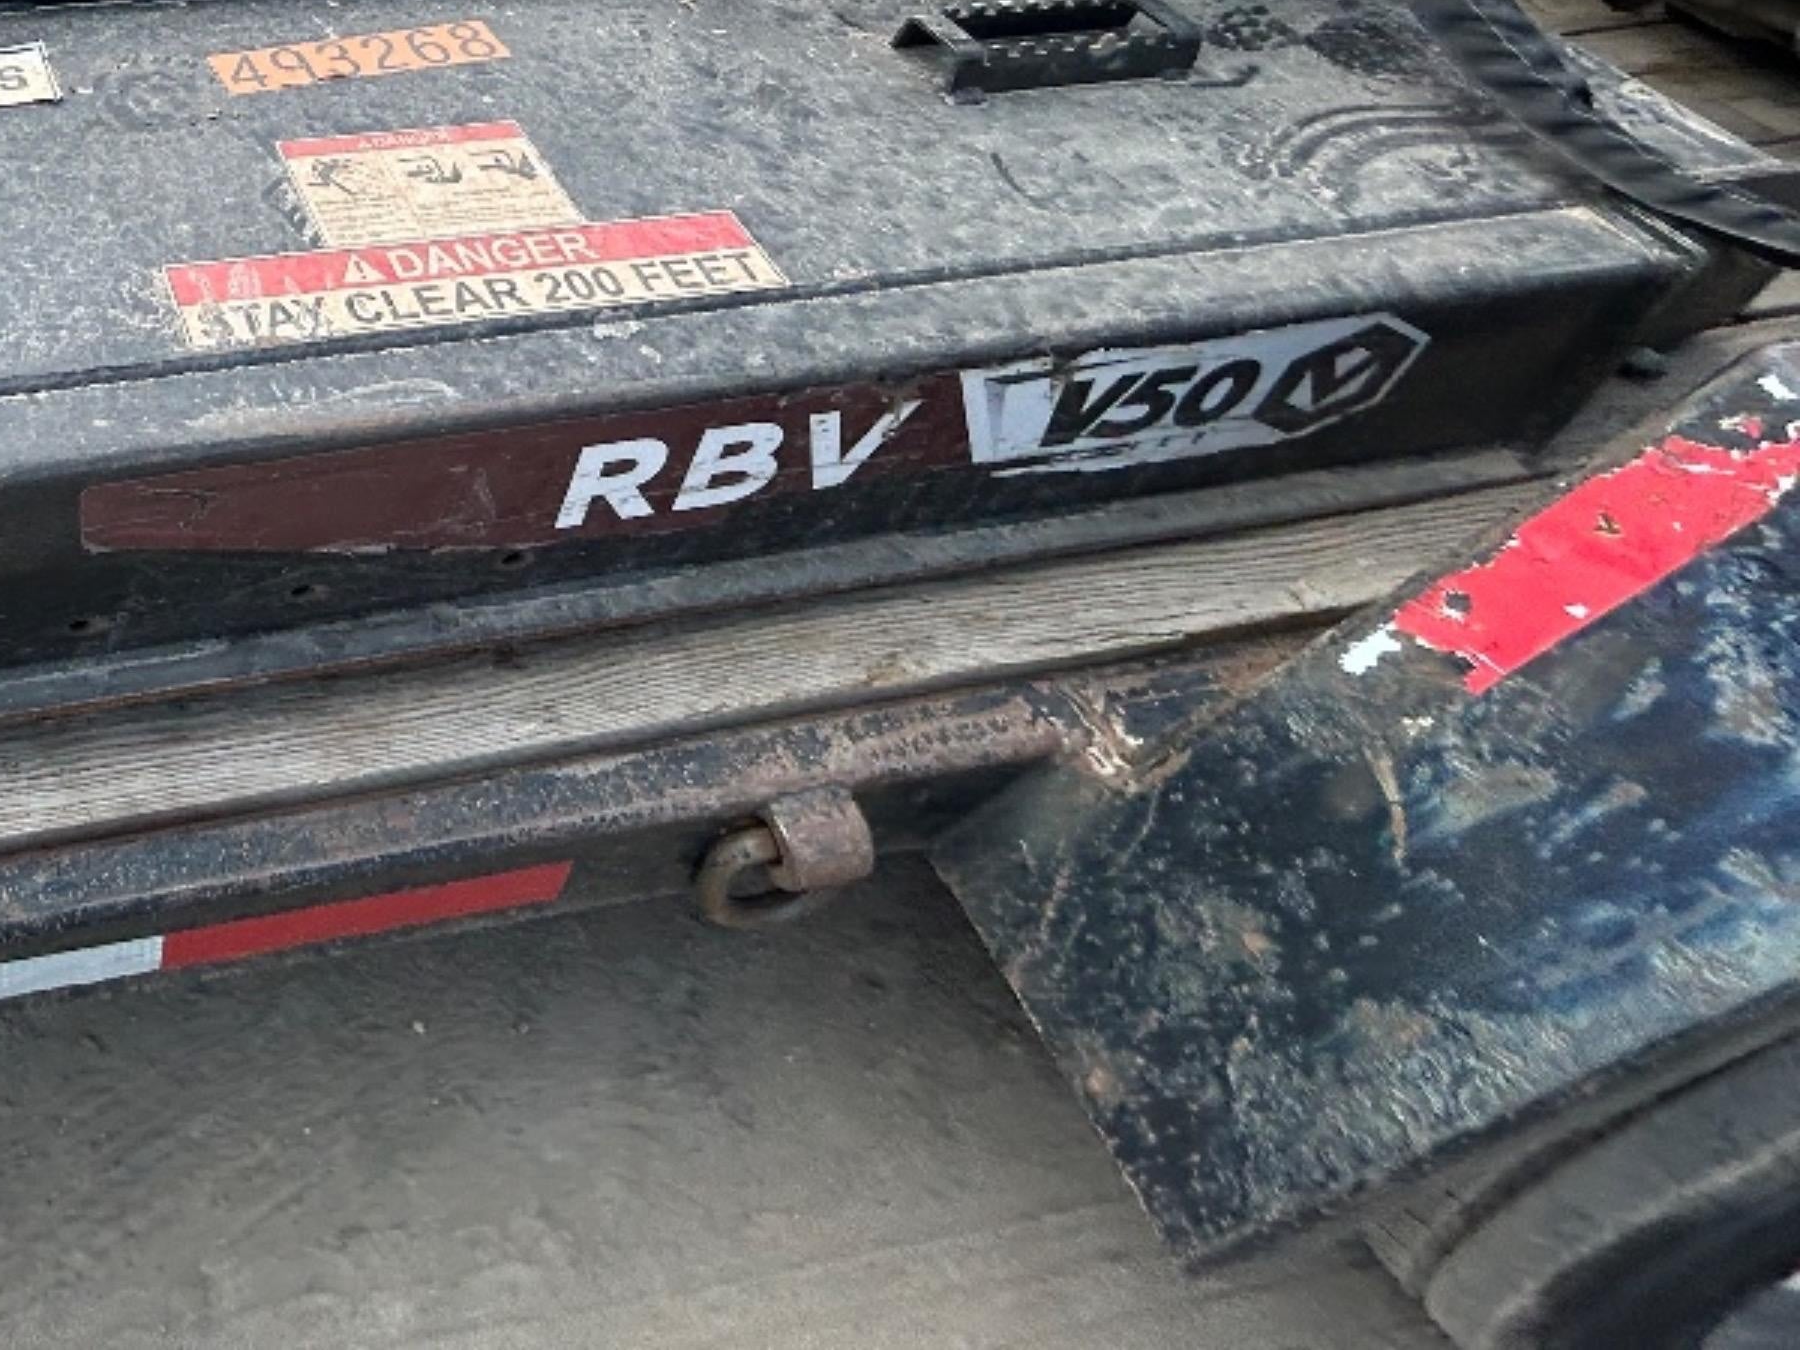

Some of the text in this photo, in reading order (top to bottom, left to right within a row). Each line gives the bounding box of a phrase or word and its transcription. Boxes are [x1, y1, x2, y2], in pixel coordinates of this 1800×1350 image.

[231, 24, 499, 88] 493268
[196, 252, 764, 339] STAY CLEAR 200 FEET
[393, 237, 597, 280] DANGER
[555, 359, 1261, 530] RBV V50
